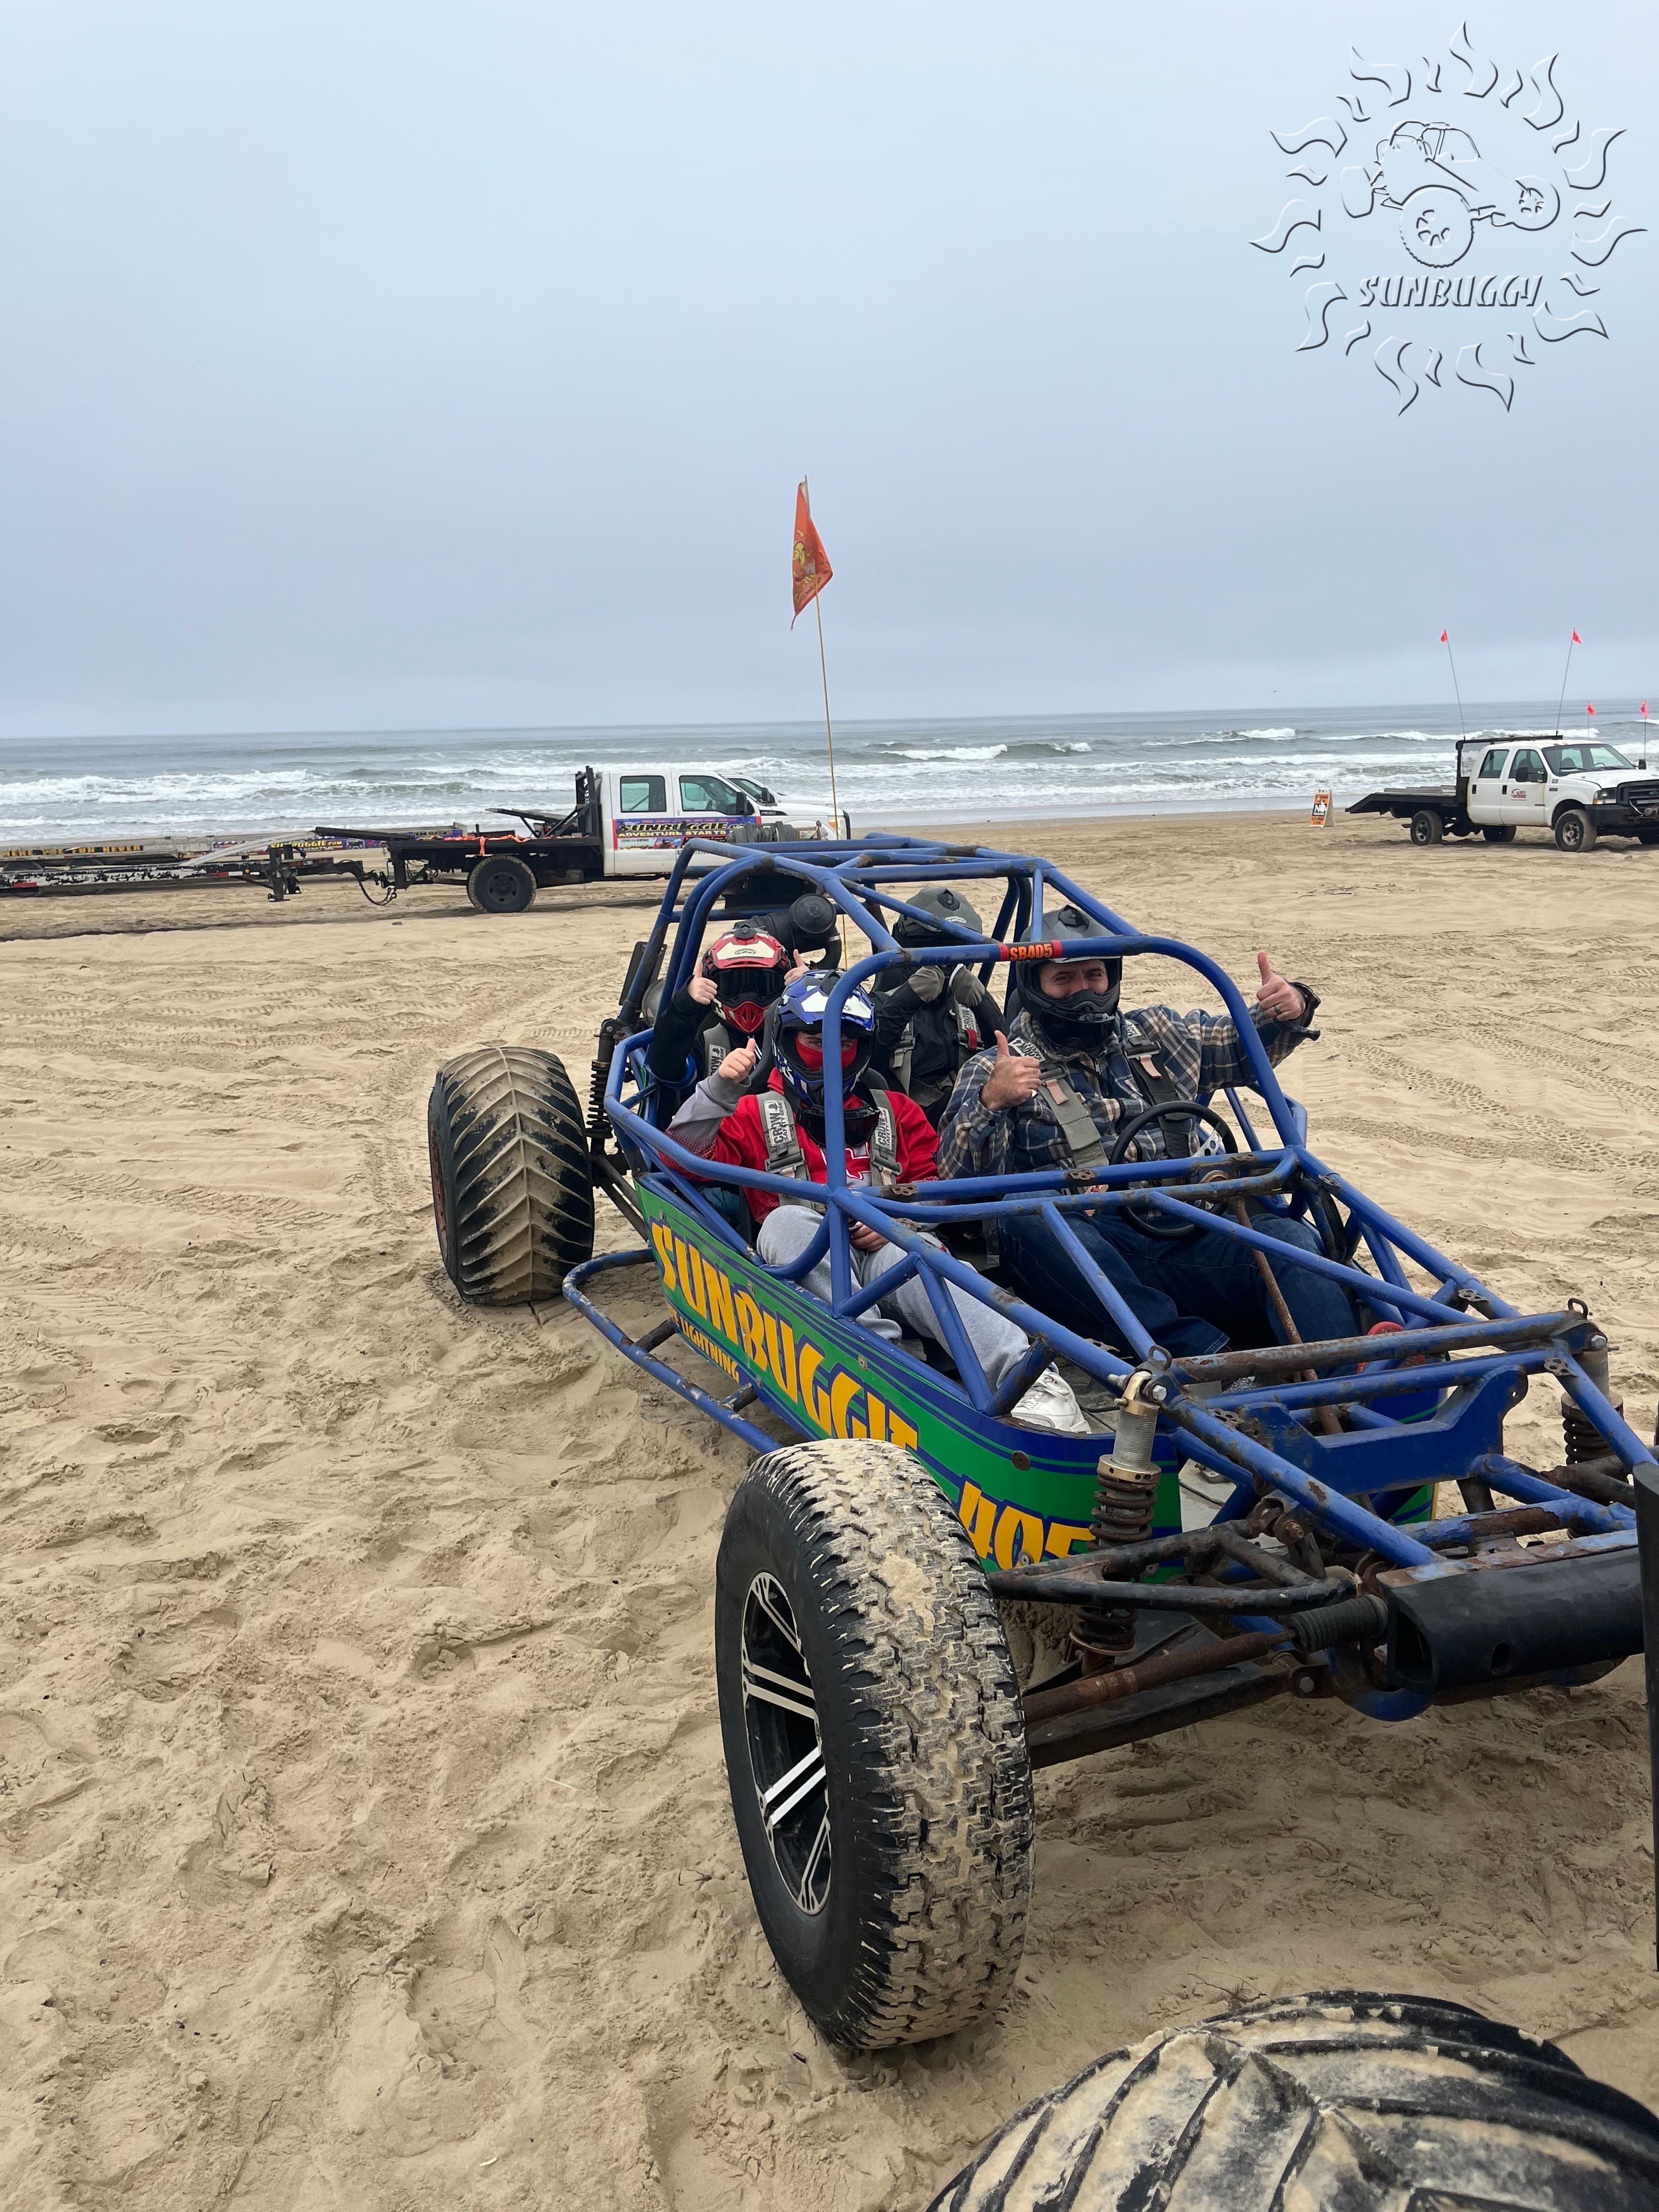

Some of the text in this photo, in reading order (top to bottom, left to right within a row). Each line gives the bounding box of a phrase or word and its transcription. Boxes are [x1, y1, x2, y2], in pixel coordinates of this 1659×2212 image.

[1010, 944, 1053, 961] SB405
[769, 1113, 784, 1144] CROW
[780, 1116, 789, 1142] SAFETY
[680, 1316, 740, 1384] LIGHTNING
